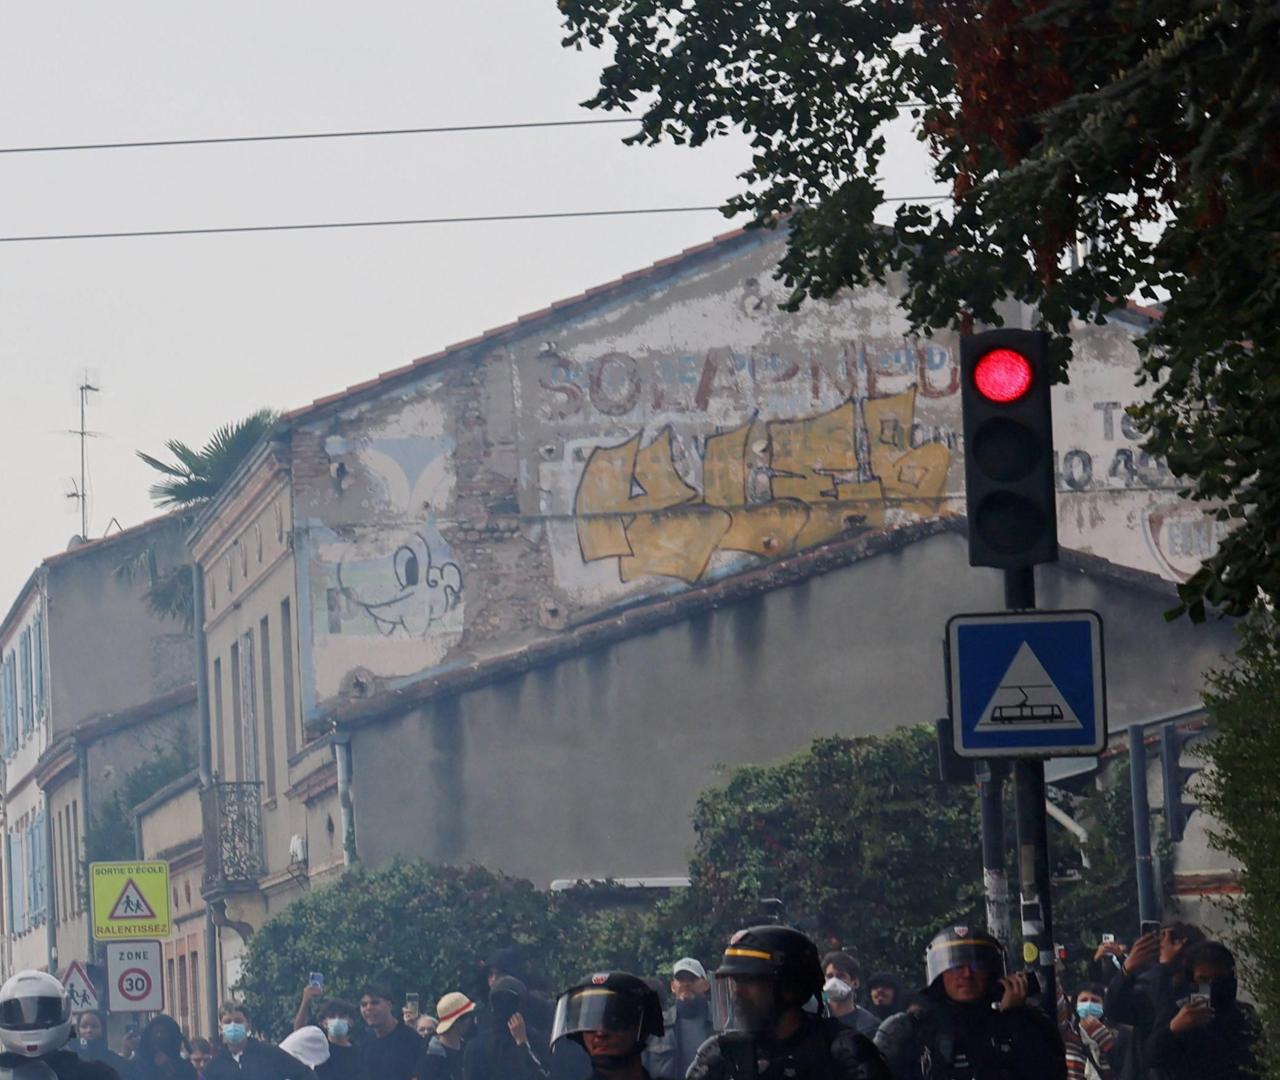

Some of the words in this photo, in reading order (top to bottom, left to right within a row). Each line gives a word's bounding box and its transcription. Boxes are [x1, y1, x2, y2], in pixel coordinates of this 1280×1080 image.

[95, 867, 125, 876] SORTIE
[128, 865, 164, 875] D'ÉCOLE
[96, 924, 168, 935] RALENTISSEZ
[118, 951, 149, 961] ZONE
[125, 977, 145, 992] 30
